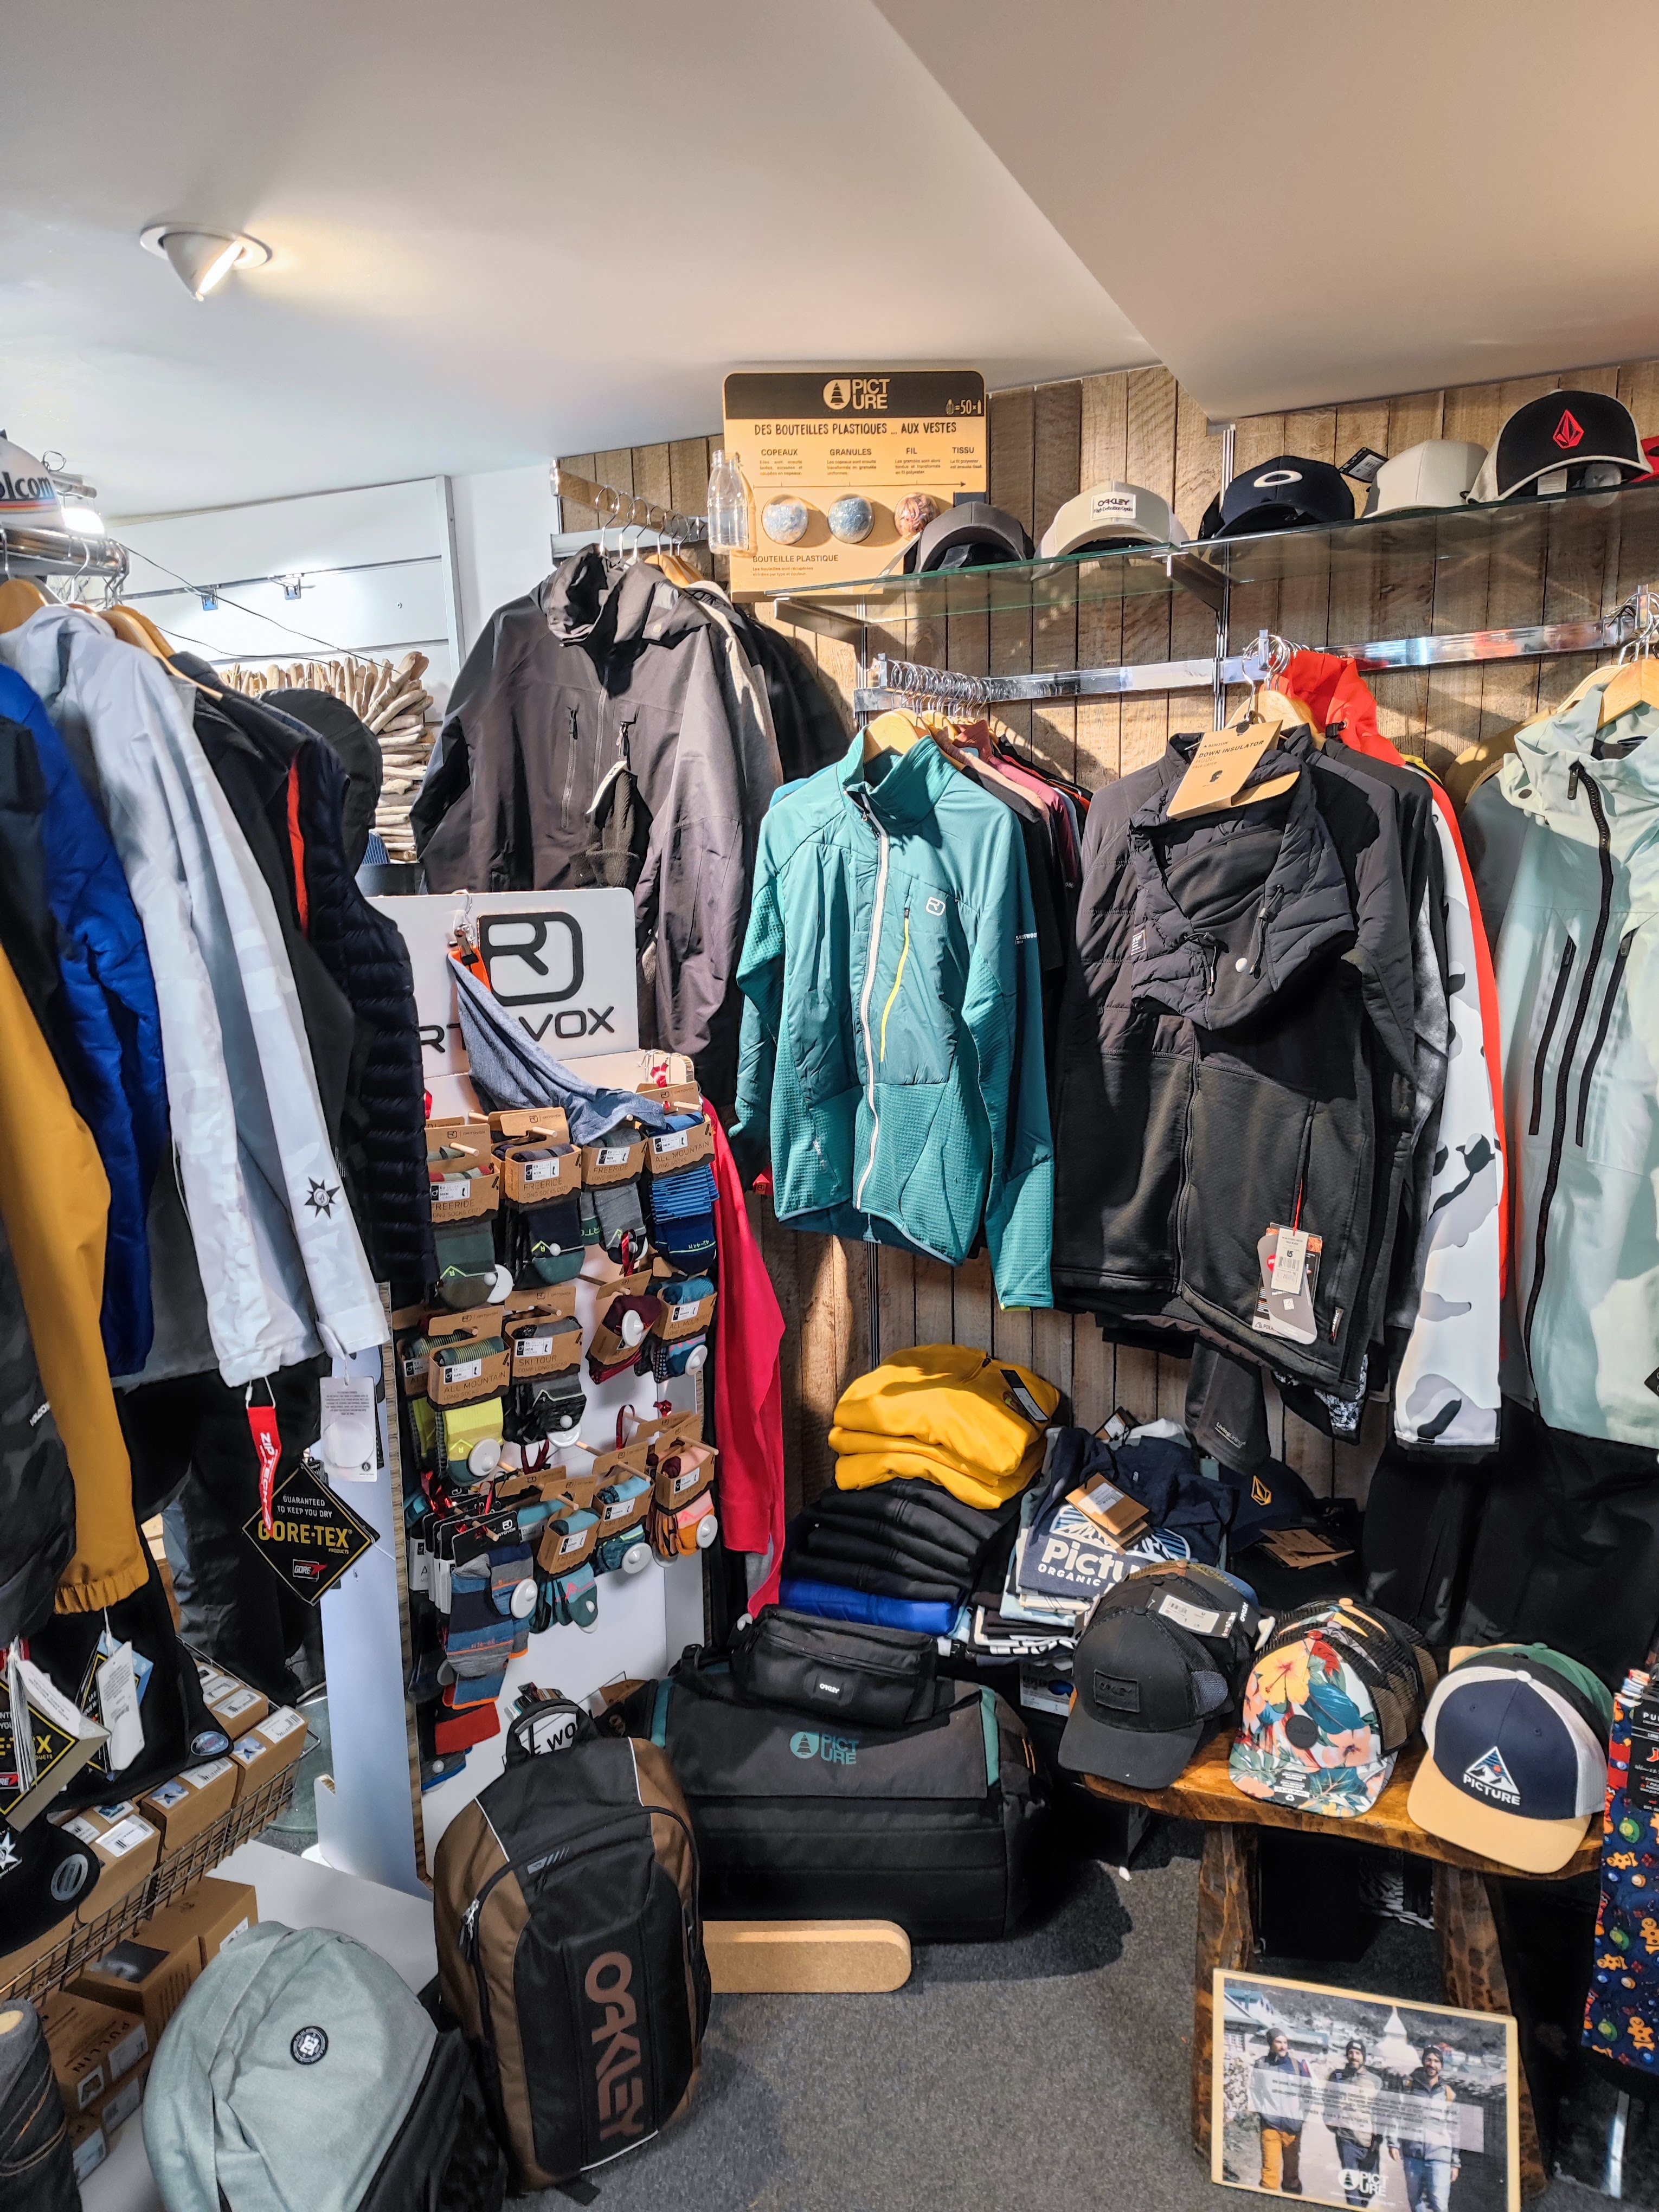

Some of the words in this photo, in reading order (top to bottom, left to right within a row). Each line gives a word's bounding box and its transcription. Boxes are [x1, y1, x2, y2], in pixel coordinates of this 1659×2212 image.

[852, 378, 890, 394] PICT
[852, 394, 888, 410] URE
[755, 424, 771, 435] DES
[775, 423, 828, 435] BOUTEILLES
[832, 423, 887, 434] PLASTIQUES
[901, 422, 919, 434] AUX
[923, 422, 956, 433] VESTES
[1098, 498, 1130, 506] OAKLEY
[1199, 750, 1220, 758] DOWN
[1222, 740, 1264, 754] INSULATOR
[655, 1155, 670, 1163] ALL
[672, 1141, 709, 1159] MOUNTAIN
[593, 1163, 628, 1174] FREERIDE
[524, 1178, 563, 1191] FREERIDE
[539, 1188, 556, 1196] SOCKS
[536, 1355, 557, 1364] TOUR
[444, 1385, 460, 1394] ALL
[464, 1371, 505, 1390] MOUNTAIN
[461, 1389, 479, 1397] SOCKS
[260, 1432, 275, 1456] ZIP
[261, 1458, 274, 1504] TECH
[283, 1495, 325, 1507] GUARANTEED
[287, 1506, 303, 1515] KEEP
[305, 1508, 317, 1516] YOU
[320, 1510, 332, 1518] DRY
[1041, 1538, 1128, 1583] Pict
[294, 1565, 312, 1574] GORE
[1038, 1563, 1102, 1586] ORGANIC
[819, 1683, 840, 1694] OAKLEY
[821, 1734, 859, 1753] PICT
[821, 1745, 857, 1765] URE
[1463, 1773, 1520, 1805] PICTURE
[584, 1951, 644, 2141] OAKLEY
[1360, 2171, 1389, 2187] PICT
[1360, 2183, 1386, 2197] URE
